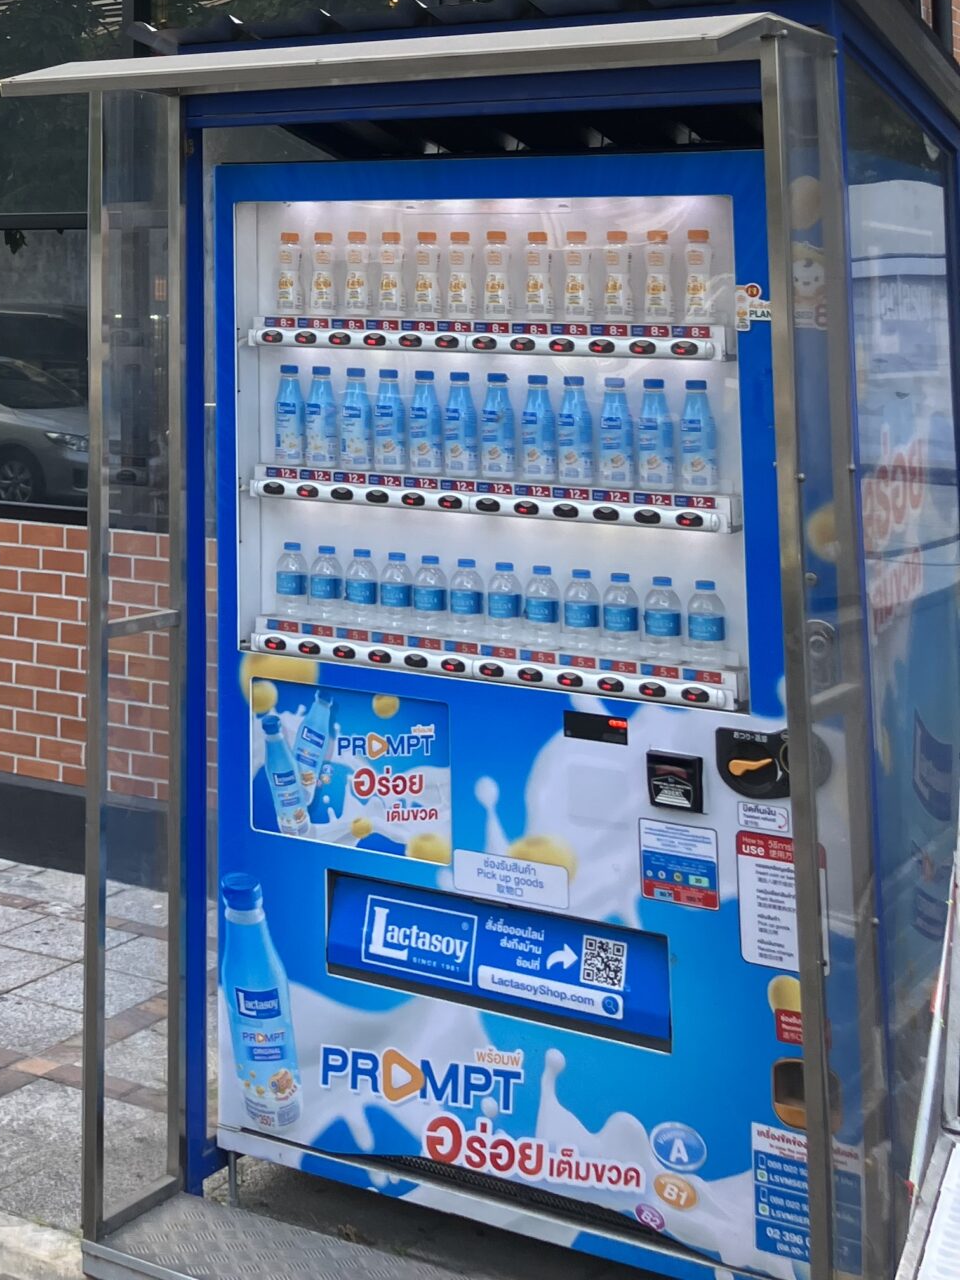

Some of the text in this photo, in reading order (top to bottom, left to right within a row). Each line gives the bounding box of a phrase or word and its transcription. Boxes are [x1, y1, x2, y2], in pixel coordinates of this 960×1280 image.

[354, 767, 423, 797] อร่อย
[387, 804, 438, 822] เต็มขวด
[742, 845, 765, 856] use
[477, 868, 544, 889] Pick up goods
[483, 857, 536, 876] ช่องรับสินค้า
[368, 906, 469, 962] Lactasoy
[485, 916, 545, 941] สั่งซื้อออนไลน์
[499, 935, 542, 955] ส่งถึงบ้าน
[412, 957, 437, 969] SINCE
[491, 974, 595, 1008] LactasoyShop.com
[237, 991, 278, 1016] Lactasoy
[426, 1116, 640, 1187] อร่อย เต็มขวด
[670, 1138, 689, 1163] A
[663, 1183, 688, 1206] B1
